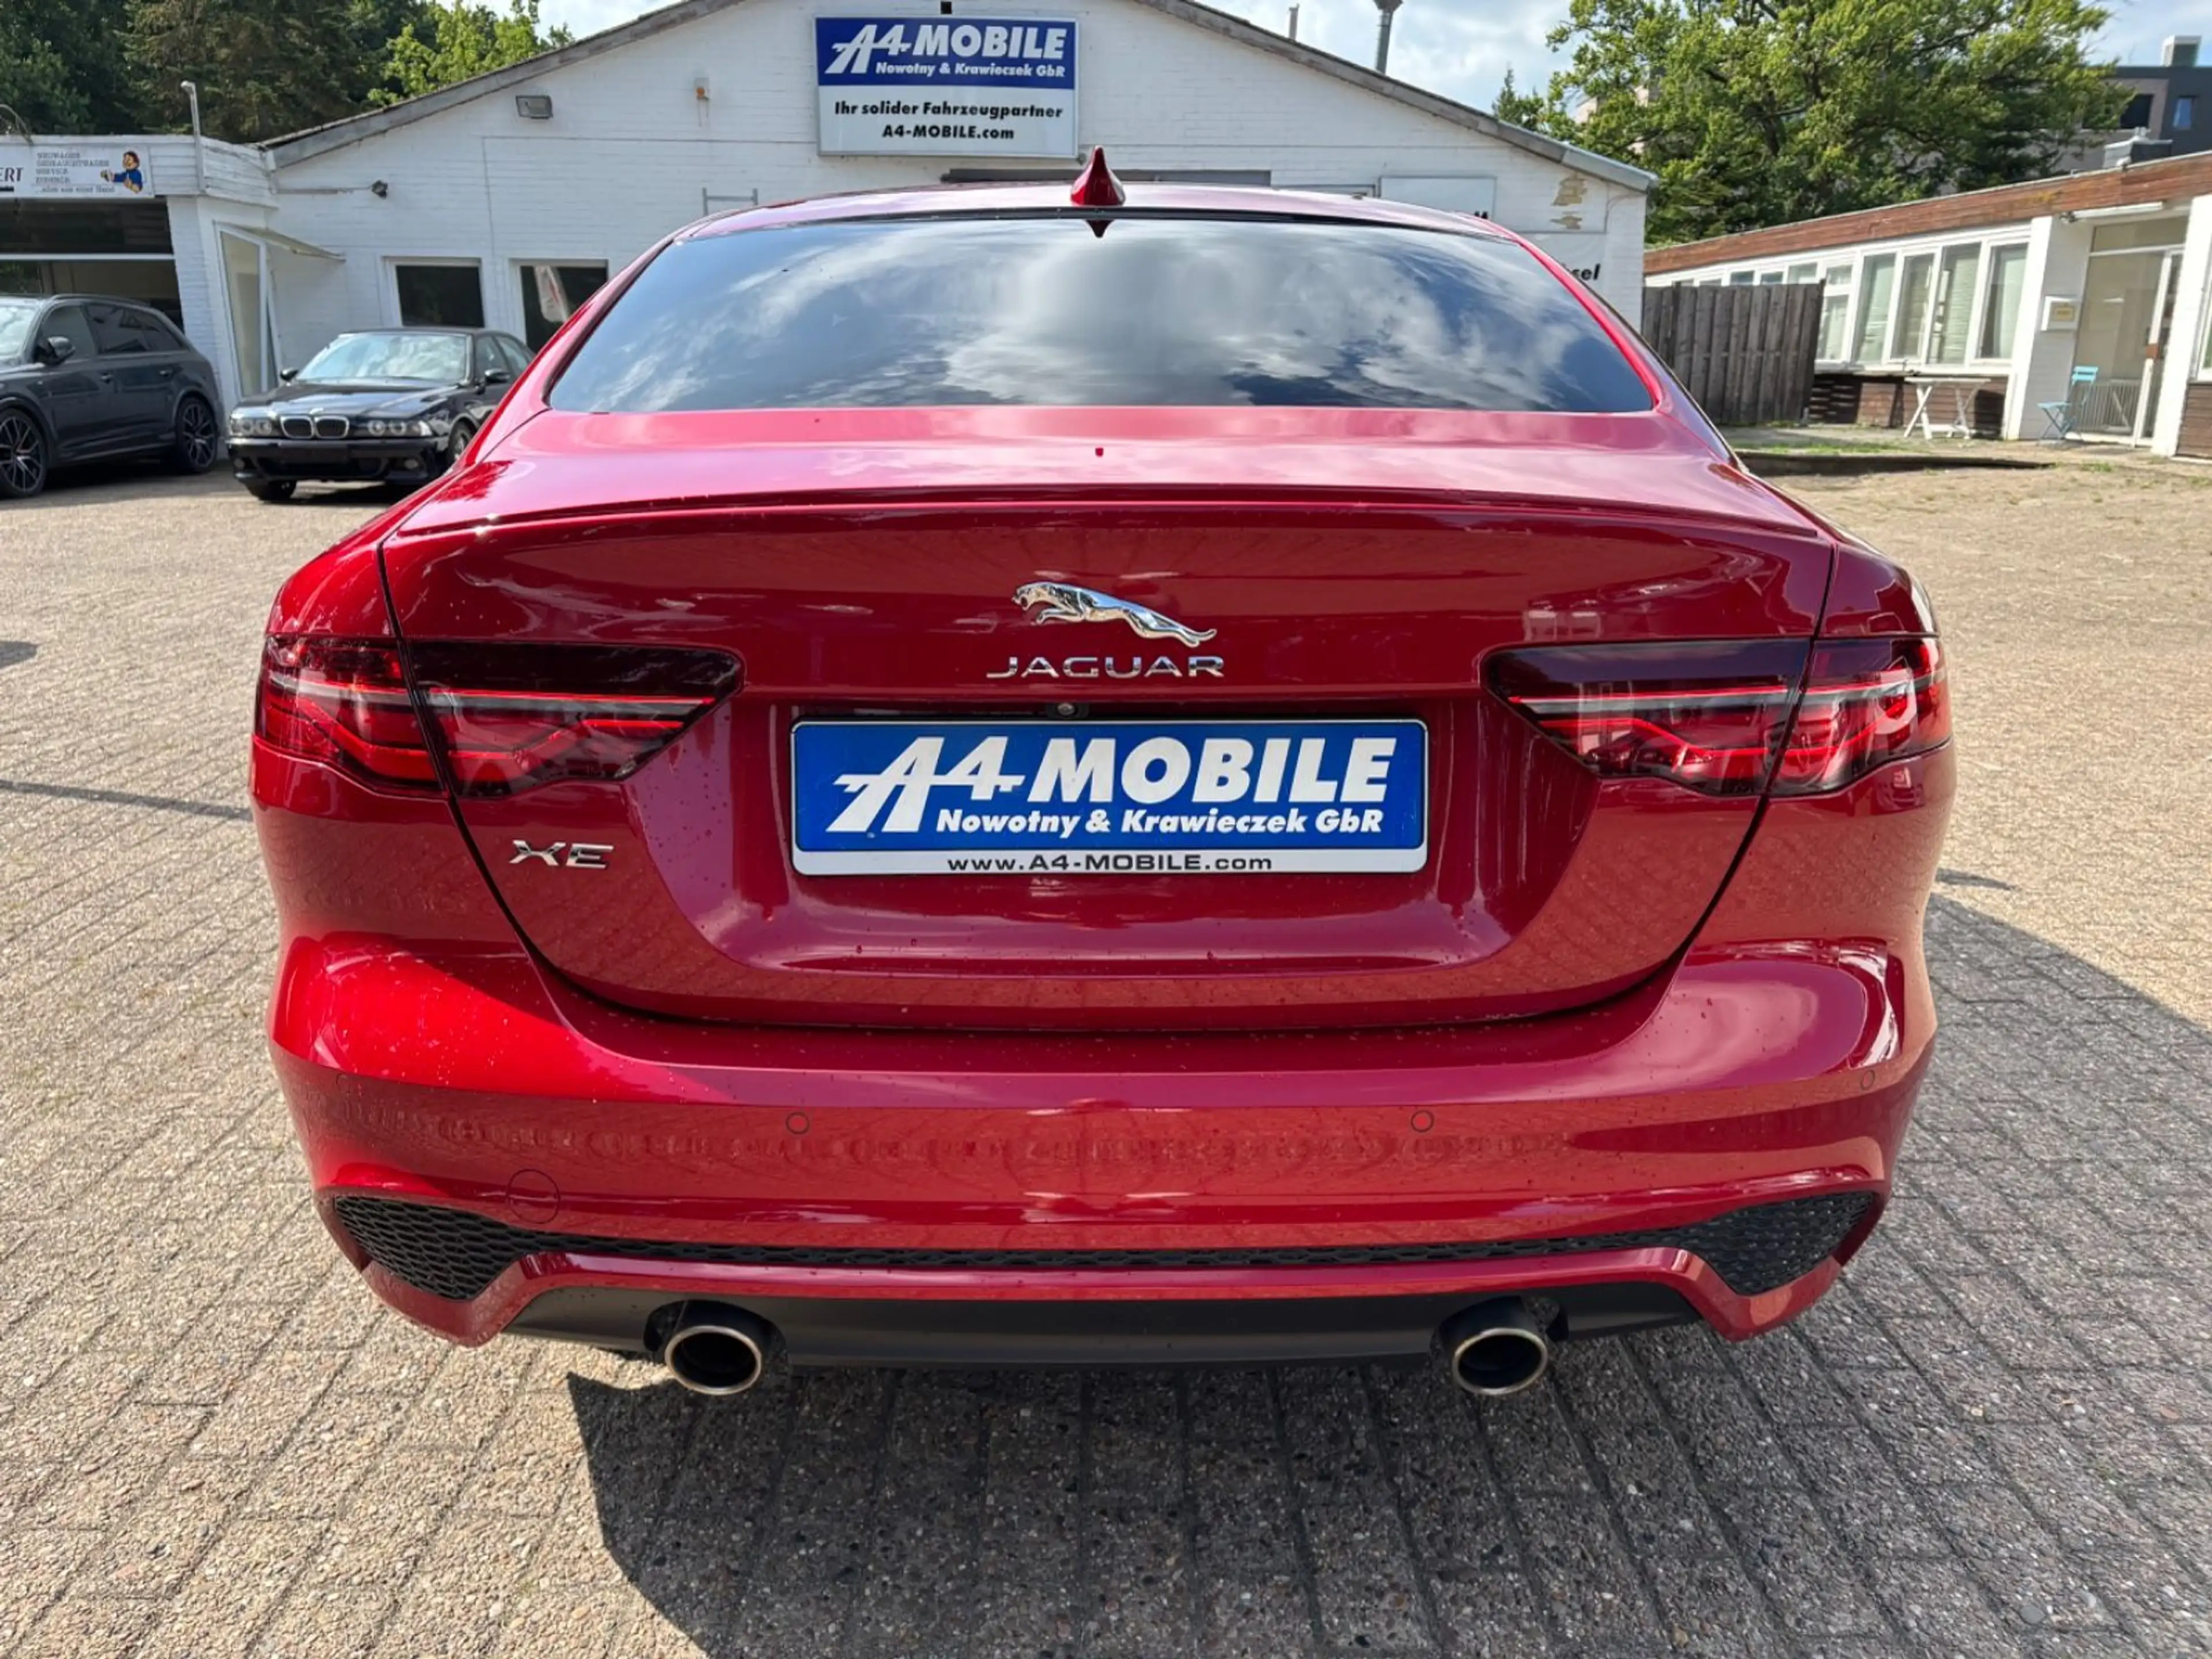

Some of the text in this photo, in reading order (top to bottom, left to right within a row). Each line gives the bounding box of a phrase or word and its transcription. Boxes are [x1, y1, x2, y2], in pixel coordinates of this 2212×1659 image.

[876, 62, 1065, 77] Nowotny & Krawieczek GbR
[835, 101, 1063, 119] Ihr solider Fahrzeugpartner
[882, 125, 1014, 139] A4-MOBILE.com
[986, 656, 1225, 679] JAGUAR
[935, 808, 1384, 839] Nowotny & Krawieczek GbR
[509, 839, 615, 869] XE
[947, 854, 1272, 872] www.A4-MOBILE.com
